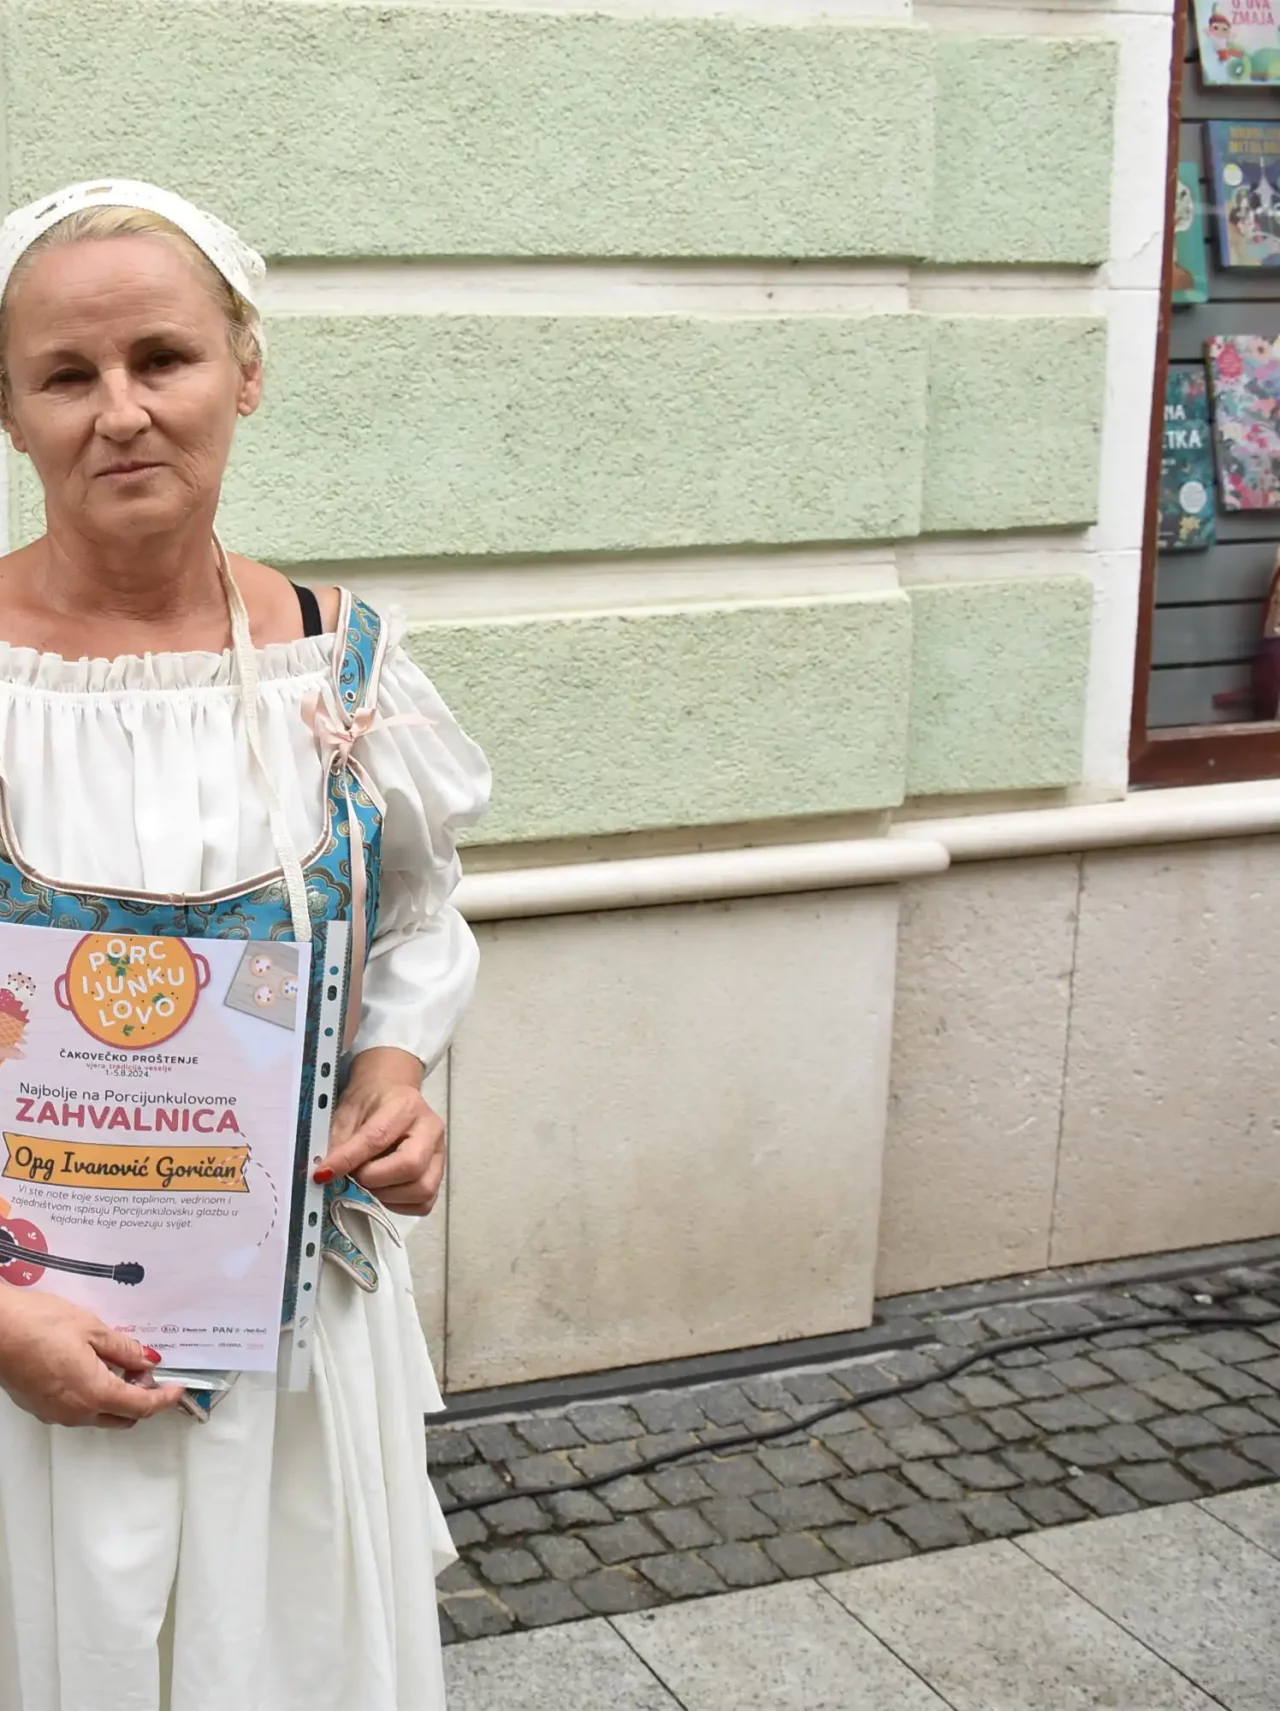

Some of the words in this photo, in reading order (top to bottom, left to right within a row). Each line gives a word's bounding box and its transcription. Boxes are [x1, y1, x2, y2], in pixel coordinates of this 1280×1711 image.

[1231, 11, 1274, 25] ZMAJA
[89, 938, 166, 972] PORC
[82, 966, 185, 1001] IJUNKU
[98, 997, 176, 1027] LOVO
[59, 1048, 128, 1063] ČAKOVEČKO
[132, 1053, 199, 1065] PROŠTENJE
[86, 1062, 106, 1071] vjera
[109, 1063, 142, 1071] tradicija
[144, 1064, 173, 1073] veselje
[20, 1082, 78, 1102] Najbolje
[82, 1089, 100, 1101] na
[105, 1090, 237, 1107] Porcijunkulovome
[15, 1097, 240, 1134] ZAHVALNICA
[15, 1146, 55, 1181] Opg
[61, 1150, 150, 1178] Ivanović
[155, 1156, 236, 1188] Goričan
[11, 1194, 72, 1213] zajedništvom
[74, 1203, 110, 1216] ispisuju
[112, 1205, 194, 1218] Porcijunkulovsku
[196, 1206, 230, 1219] glazbu
[18, 1184, 28, 1194] Vi
[29, 1186, 44, 1197] ste
[46, 1189, 69, 1200] note
[71, 1191, 91, 1204] koje
[94, 1194, 129, 1207] svojom
[132, 1194, 178, 1208] toplinom,
[180, 1194, 226, 1205] vedrinom
[50, 1214, 95, 1228] kajdanke
[97, 1217, 118, 1229] koje
[119, 1218, 164, 1230] povezuju
[166, 1217, 193, 1229] svijet.
[212, 1326, 233, 1334] PAN
